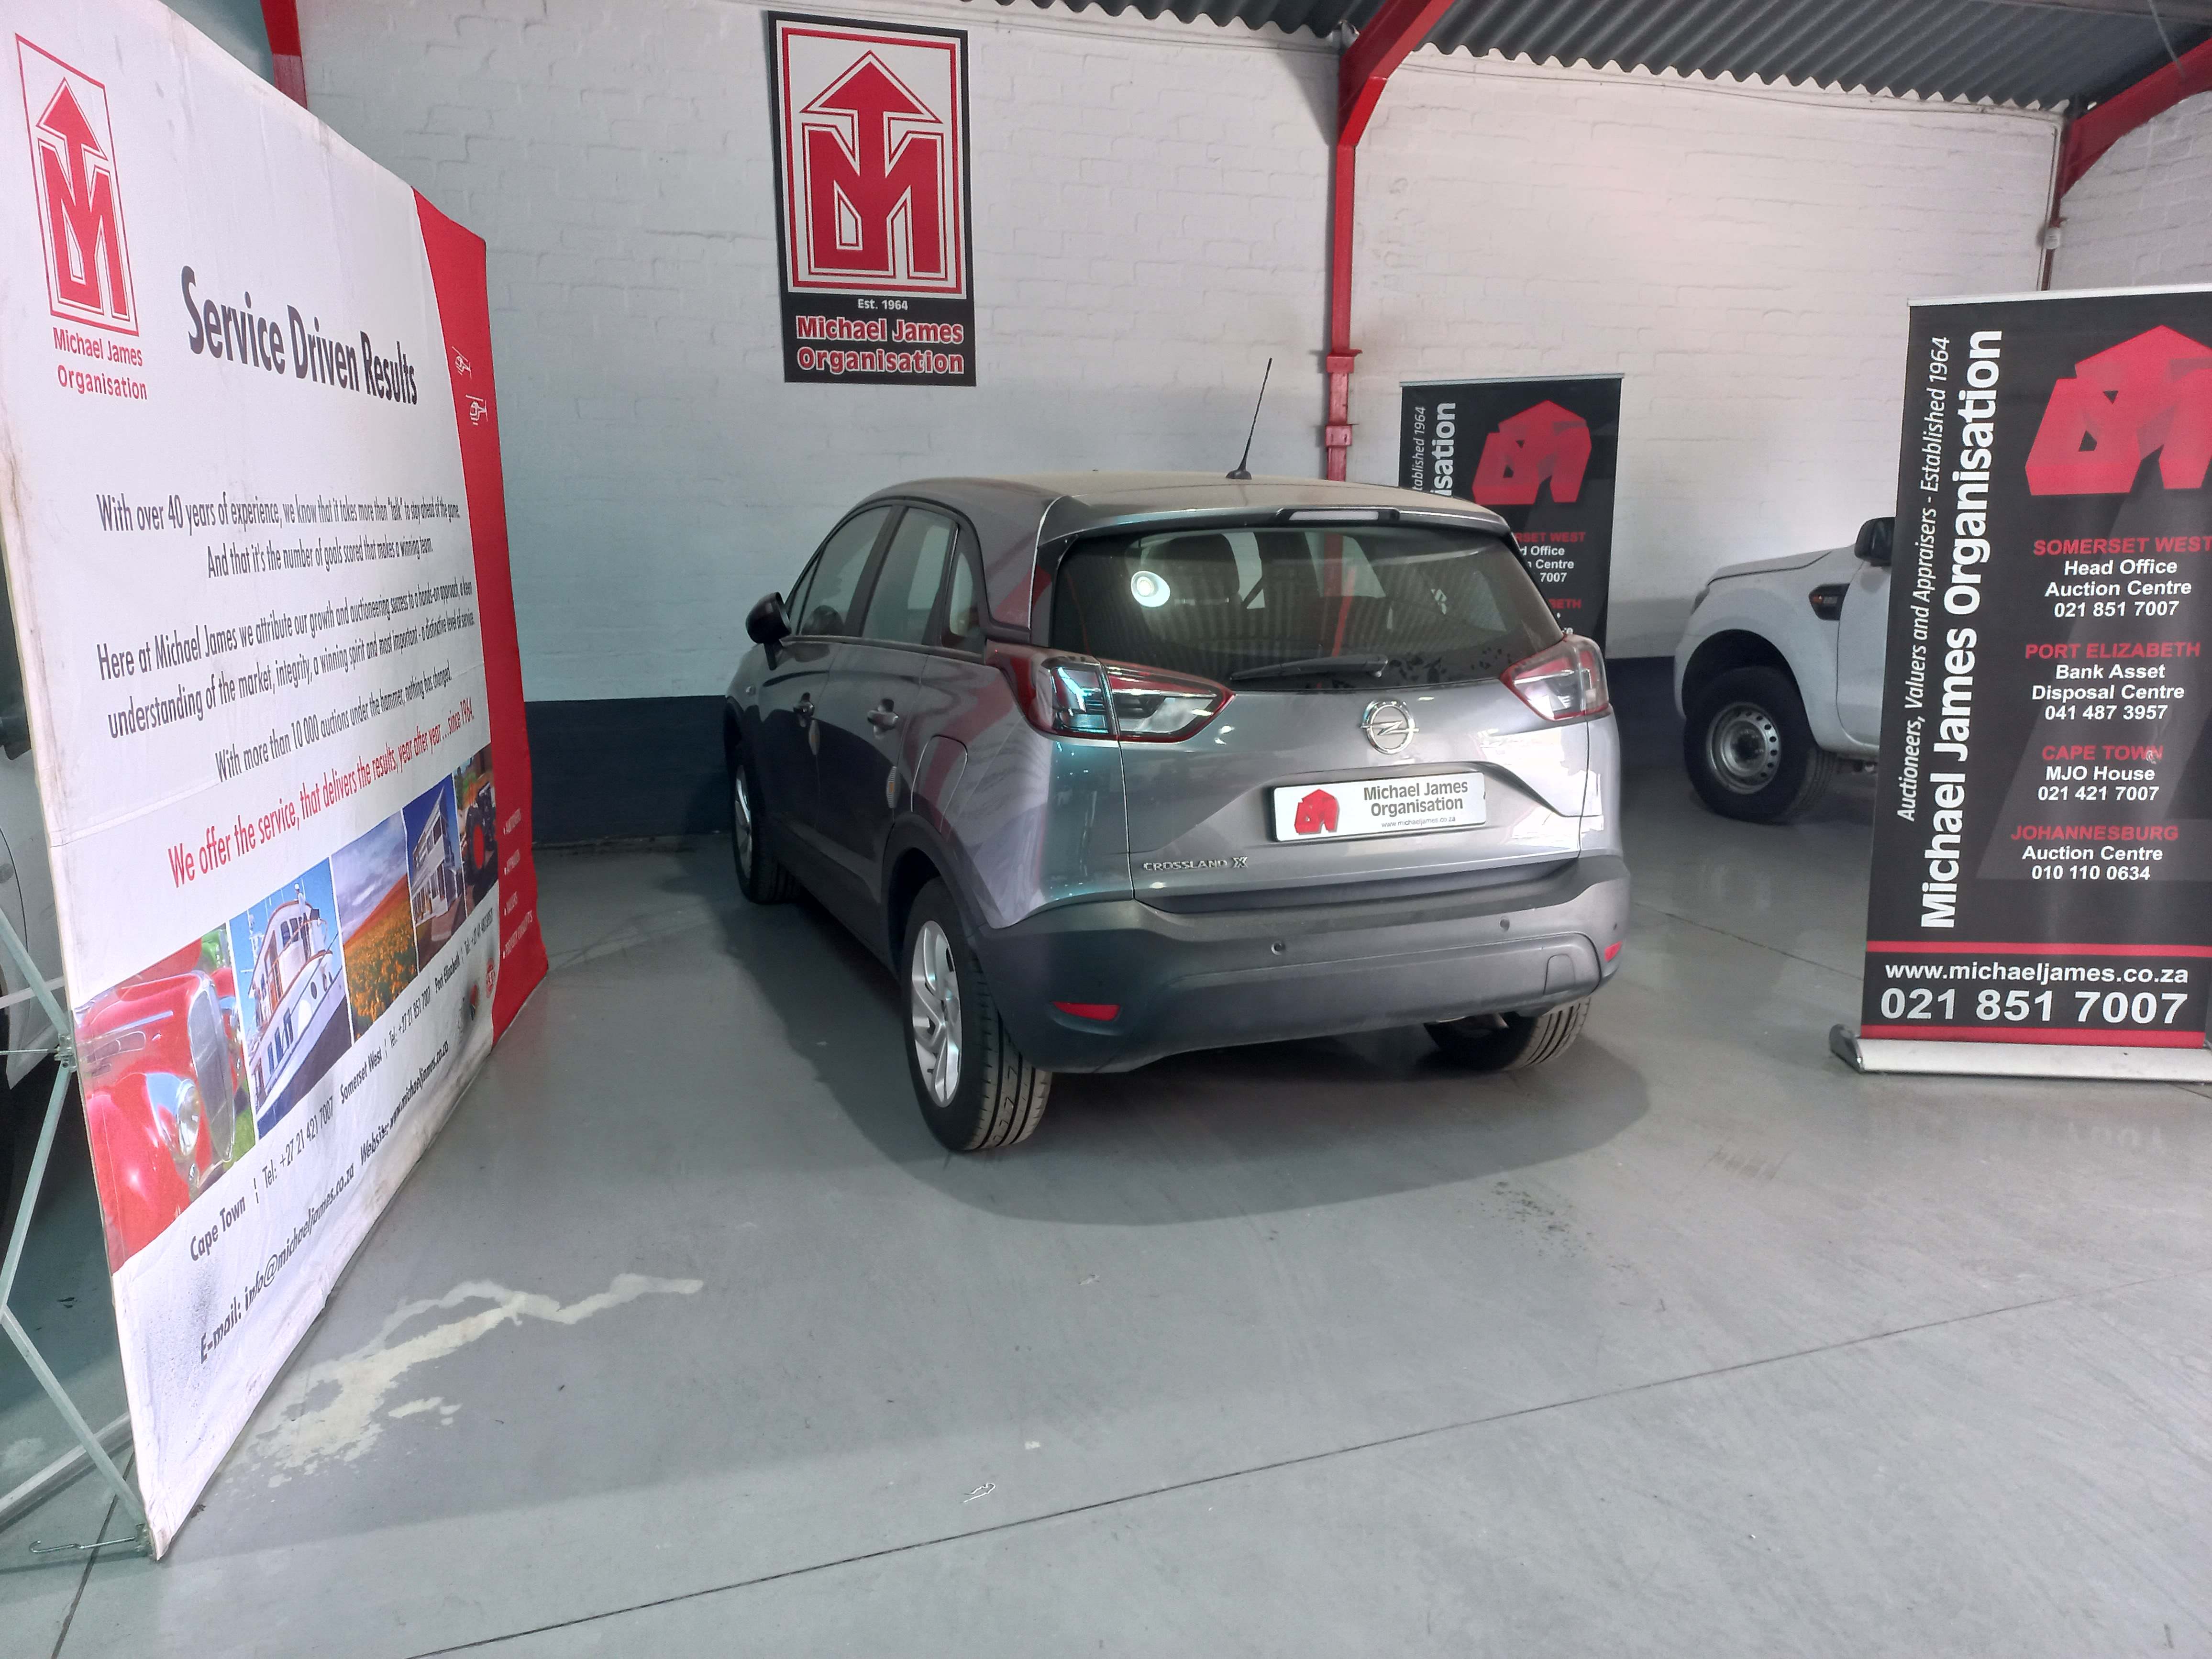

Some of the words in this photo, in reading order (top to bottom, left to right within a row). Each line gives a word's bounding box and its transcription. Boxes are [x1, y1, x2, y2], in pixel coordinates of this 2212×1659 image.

[858, 299, 878, 310] Est.
[882, 300, 908, 310] 1964
[181, 265, 287, 375] Service
[287, 304, 360, 392] Driven
[360, 331, 418, 405] Results
[796, 315, 888, 342] Michael
[892, 319, 964, 344] James
[53, 327, 104, 360] Michael
[106, 337, 143, 367] James
[797, 346, 964, 375] Organisation
[1929, 336, 1950, 383] 1964
[57, 364, 147, 401] Organisation
[1414, 406, 1426, 435] 1964
[1430, 403, 1456, 496] isation
[1920, 387, 1946, 492] Established
[1412, 437, 1425, 491] tablished
[1944, 329, 2002, 617] Organisation
[96, 493, 133, 531] With
[137, 506, 164, 531] over
[168, 494, 184, 529] 40
[185, 503, 216, 536] years
[218, 491, 229, 525] of
[231, 495, 282, 532] experience,
[282, 503, 295, 523] we
[295, 493, 317, 523] know
[318, 494, 333, 523] that
[332, 498, 339, 522] it
[340, 495, 357, 522] takes
[358, 504, 374, 521] more
[374, 496, 388, 521] than
[1515, 532, 1547, 542] RSET
[1550, 531, 1586, 542] WEST
[1531, 545, 1565, 556] Office
[2033, 537, 2150, 556] SOMERSET
[2155, 536, 2212, 553] WEST
[208, 542, 229, 578] And
[230, 542, 251, 575] that
[251, 542, 265, 572] it's
[266, 540, 282, 571] the
[283, 538, 313, 569] number
[315, 537, 323, 566] of
[324, 536, 343, 572] goals
[343, 534, 364, 563] scored
[364, 534, 377, 560] that
[377, 534, 395, 559] makes
[1536, 559, 1575, 569] Centre
[1912, 507, 1937, 603] Appraisers
[2064, 560, 2113, 575] Head
[2119, 558, 2178, 575] Office
[1540, 572, 1567, 582] 7007
[2044, 581, 2120, 597] Auction
[2127, 580, 2192, 596] Centre
[1910, 604, 1930, 641] and
[2054, 602, 2086, 618] 021
[2092, 601, 2126, 617] 851
[2134, 600, 2180, 616] 7007
[97, 643, 135, 681] Here
[138, 641, 152, 673] at
[155, 625, 202, 670] Michael
[204, 624, 238, 657] James
[239, 625, 254, 648] we
[255, 609, 293, 644] attribute
[294, 614, 308, 636] our
[310, 600, 335, 639] growth
[336, 597, 349, 627] and
[350, 594, 391, 621] auctioneering
[2025, 643, 2081, 659] PORT
[2086, 641, 2201, 659] ELIZABETH
[108, 684, 204, 739] understanding
[205, 673, 217, 709] of
[218, 670, 236, 705] the
[238, 661, 275, 699] market,
[275, 653, 313, 688] integrity,
[313, 656, 319, 675] a
[320, 644, 348, 673] winning
[349, 638, 365, 670] spirit
[366, 631, 378, 660] and
[379, 632, 392, 655] most
[393, 625, 418, 655] important
[1904, 644, 1926, 709] Valuers
[2056, 664, 2104, 680] Bank
[2108, 663, 2166, 679] Asset
[1933, 626, 1978, 763] James
[2032, 685, 2115, 703] Disposal
[2121, 684, 2185, 700] Centre
[2045, 705, 2076, 720] 041
[2082, 705, 2117, 720] 487
[2123, 704, 2168, 720] 3957
[215, 743, 242, 783] With
[243, 742, 269, 771] more
[269, 728, 291, 759] than
[291, 719, 303, 749] 10
[303, 714, 320, 744] 000
[321, 708, 350, 738] auctions
[349, 696, 369, 726] under
[369, 692, 380, 717] the
[379, 688, 405, 712] hammer,
[2042, 745, 2096, 761] CAPE
[2101, 745, 2164, 761] TOWN
[1897, 715, 1926, 822] Auctioneers,
[2046, 765, 2088, 781] MJO
[2093, 765, 2156, 781] House
[1363, 783, 1420, 801] Michael
[1424, 781, 1468, 796] James
[2037, 785, 2069, 801] 021
[2075, 785, 2106, 801] 421
[2115, 785, 2160, 801] 7007
[168, 843, 195, 888] We
[199, 826, 231, 874] offer
[234, 815, 256, 857] the
[258, 798, 300, 844] service,
[299, 782, 321, 820] that
[323, 768, 357, 808] delivers
[356, 755, 372, 790] the
[372, 742, 398, 781] results,
[398, 739, 413, 774] year
[413, 725, 428, 757] after
[1371, 796, 1463, 817] Organisation
[2011, 825, 2179, 841] JOHANNESBURG
[1143, 859, 1228, 871] CROSSLAND
[1232, 856, 1248, 868] X
[1920, 772, 1966, 930] Michael
[2022, 845, 2094, 861] Auction
[2101, 845, 2163, 861] Centre
[2032, 865, 2063, 880] 010
[2069, 865, 2101, 880] 110
[2106, 865, 2151, 881] 0634
[1885, 961, 2189, 985] www.michaeljames.co.za
[1880, 987, 1956, 1020] 021
[1976, 988, 2052, 1022] 851
[2075, 990, 2189, 1024] 7007
[340, 1062, 367, 1104] Somerset
[367, 1046, 382, 1073] West
[413, 997, 421, 1019] 851
[421, 985, 431, 1010] 7007
[360, 1122, 389, 1166] Website:
[190, 1223, 219, 1262] Cape
[219, 1195, 246, 1232] Town
[262, 1159, 278, 1189] Tel:
[279, 1138, 295, 1169] +27
[295, 1128, 305, 1156] 21
[306, 1114, 319, 1145] 421
[319, 1095, 334, 1141] 7007
[200, 1296, 242, 1365] E-mail:
[244, 1162, 355, 1313] info@michaeljames.co.za
